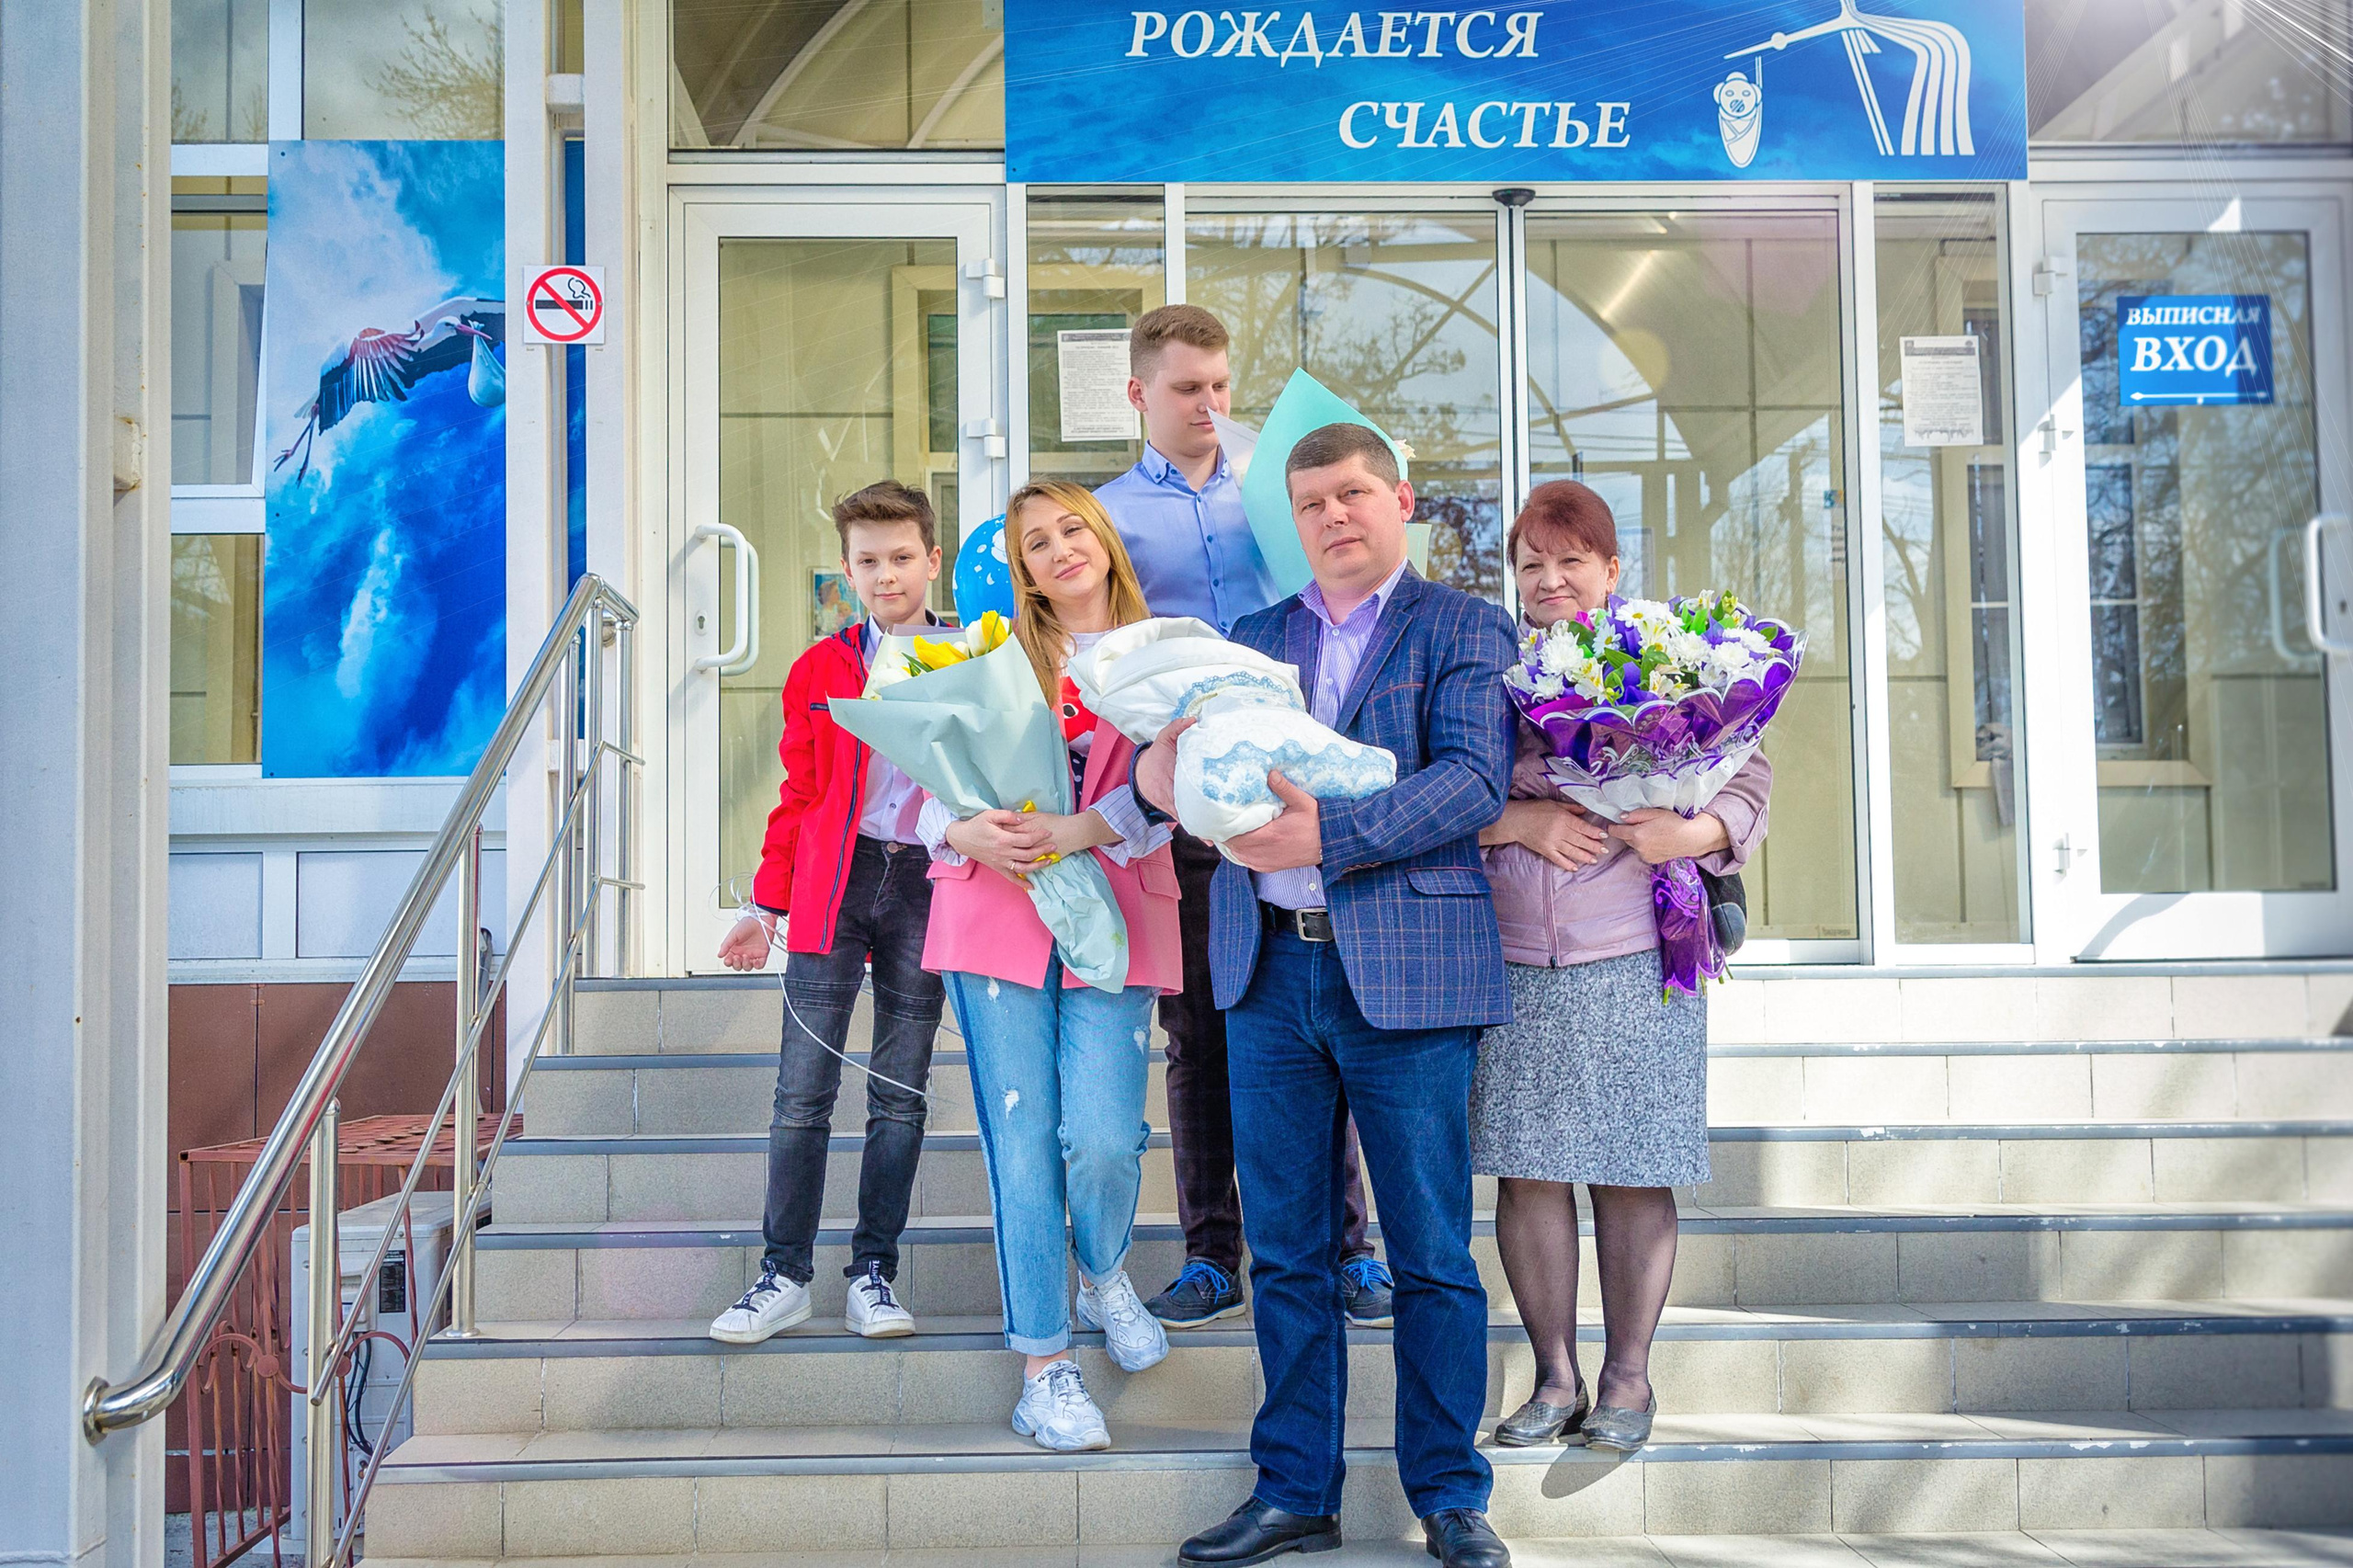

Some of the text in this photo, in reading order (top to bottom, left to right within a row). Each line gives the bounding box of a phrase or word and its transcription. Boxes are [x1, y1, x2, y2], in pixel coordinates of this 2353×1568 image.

[1124, 10, 1544, 68] РОЖДАЕТСЯ
[1338, 100, 1631, 149] СЧАСТЬЕ
[2125, 306, 2261, 325] ВЫПИСНАЯ
[2130, 335, 2257, 378] ВХОД
